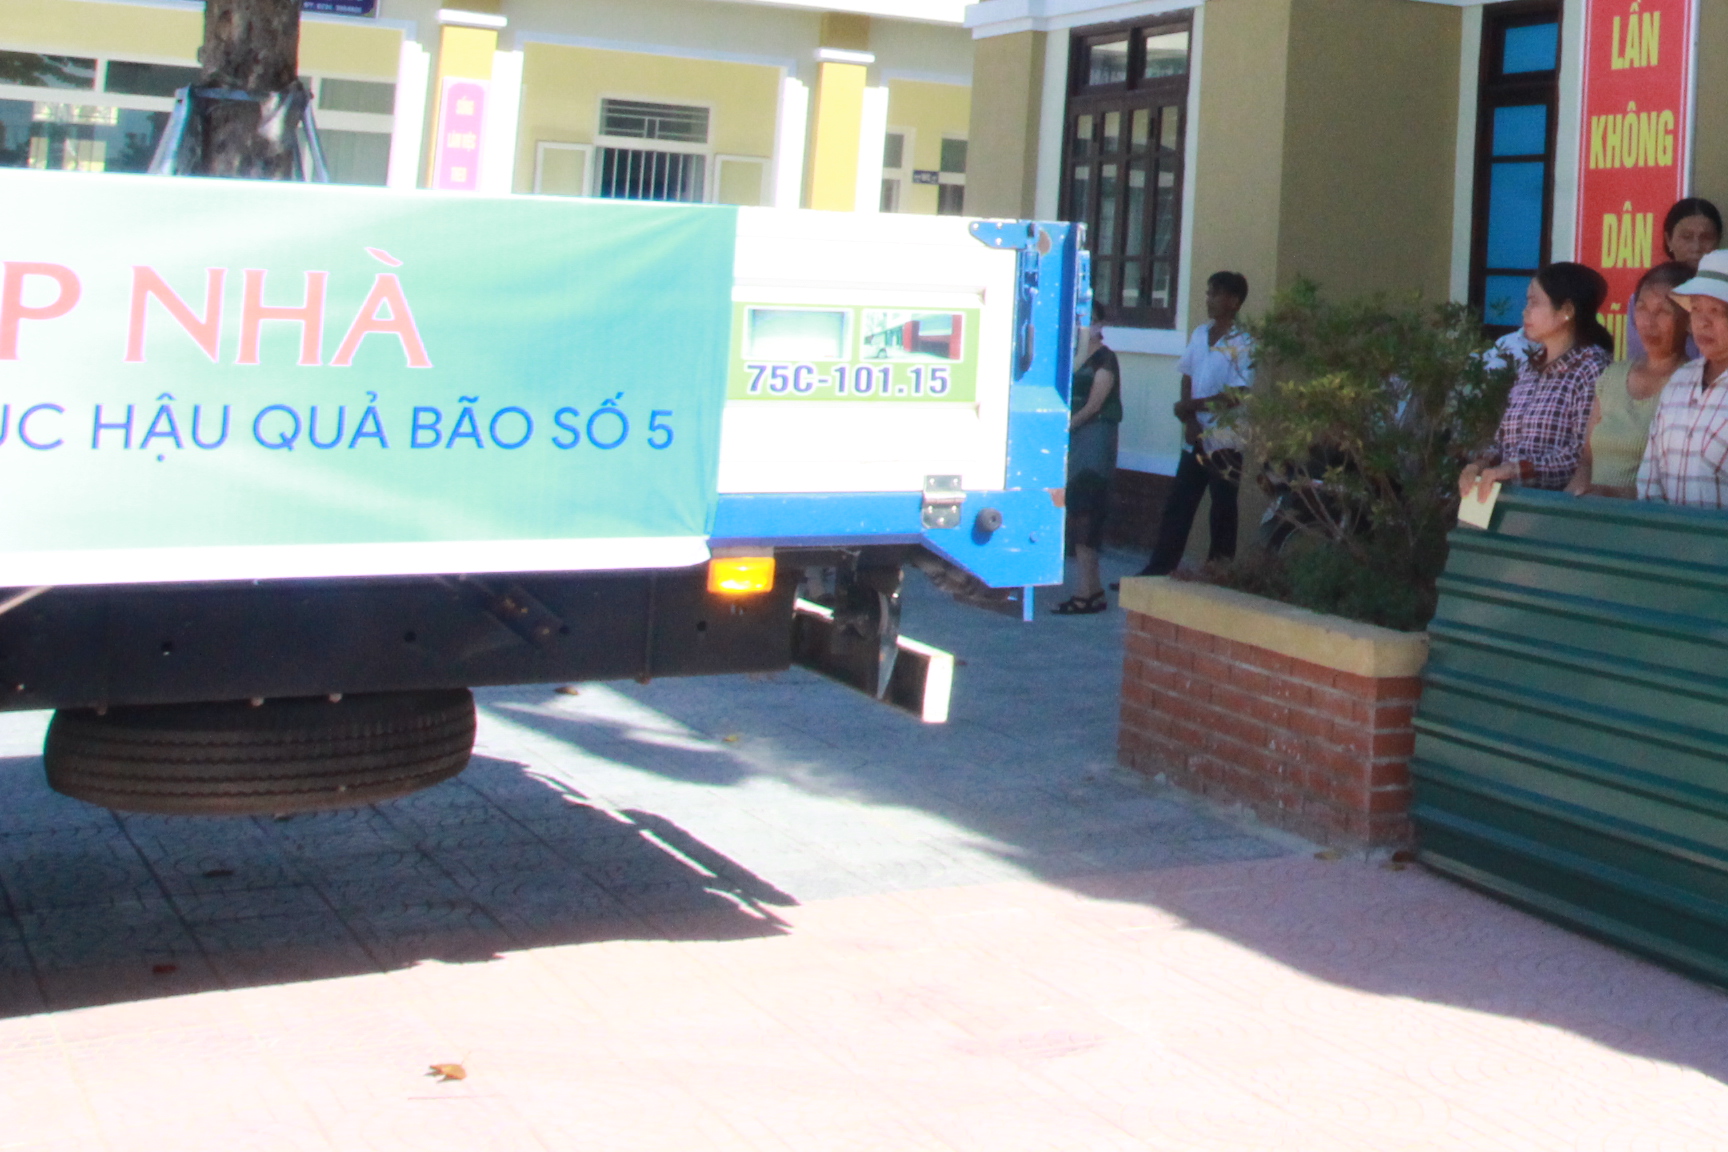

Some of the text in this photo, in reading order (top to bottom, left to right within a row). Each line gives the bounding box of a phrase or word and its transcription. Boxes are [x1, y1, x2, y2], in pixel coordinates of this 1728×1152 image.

[1590, 101, 1674, 170] KHÔNG
[1601, 201, 1653, 269] DÂN
[123, 247, 433, 368] NHÀ
[745, 364, 950, 396] 75C-101.15
[91, 393, 231, 462] HẬU
[252, 391, 389, 451] QUẢ
[410, 396, 534, 450] BÃO
[551, 393, 629, 450] SỐ
[647, 409, 674, 450] 5
